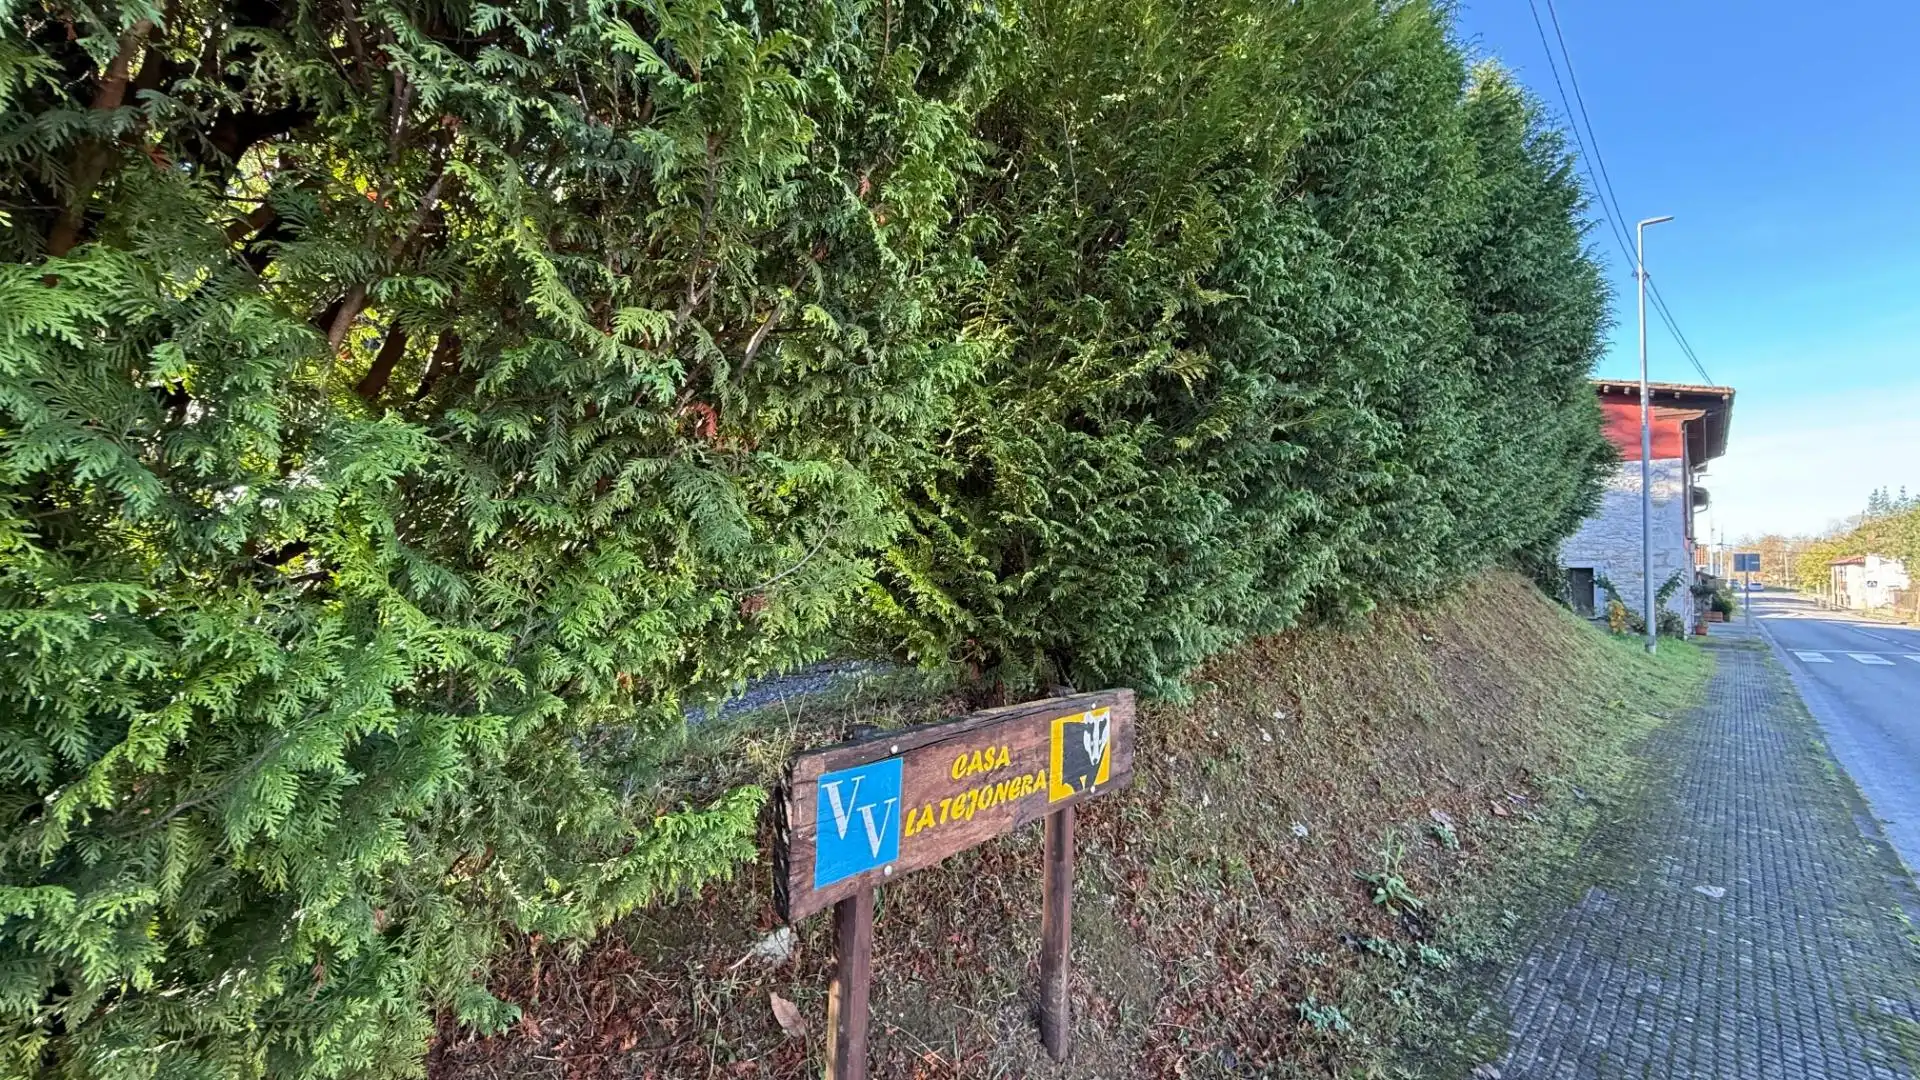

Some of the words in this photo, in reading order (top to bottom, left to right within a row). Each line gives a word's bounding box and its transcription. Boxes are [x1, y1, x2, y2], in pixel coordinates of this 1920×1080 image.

[951, 744, 1011, 780] CASA
[904, 803, 937, 837] LA
[939, 768, 1047, 825] TEJONERA
